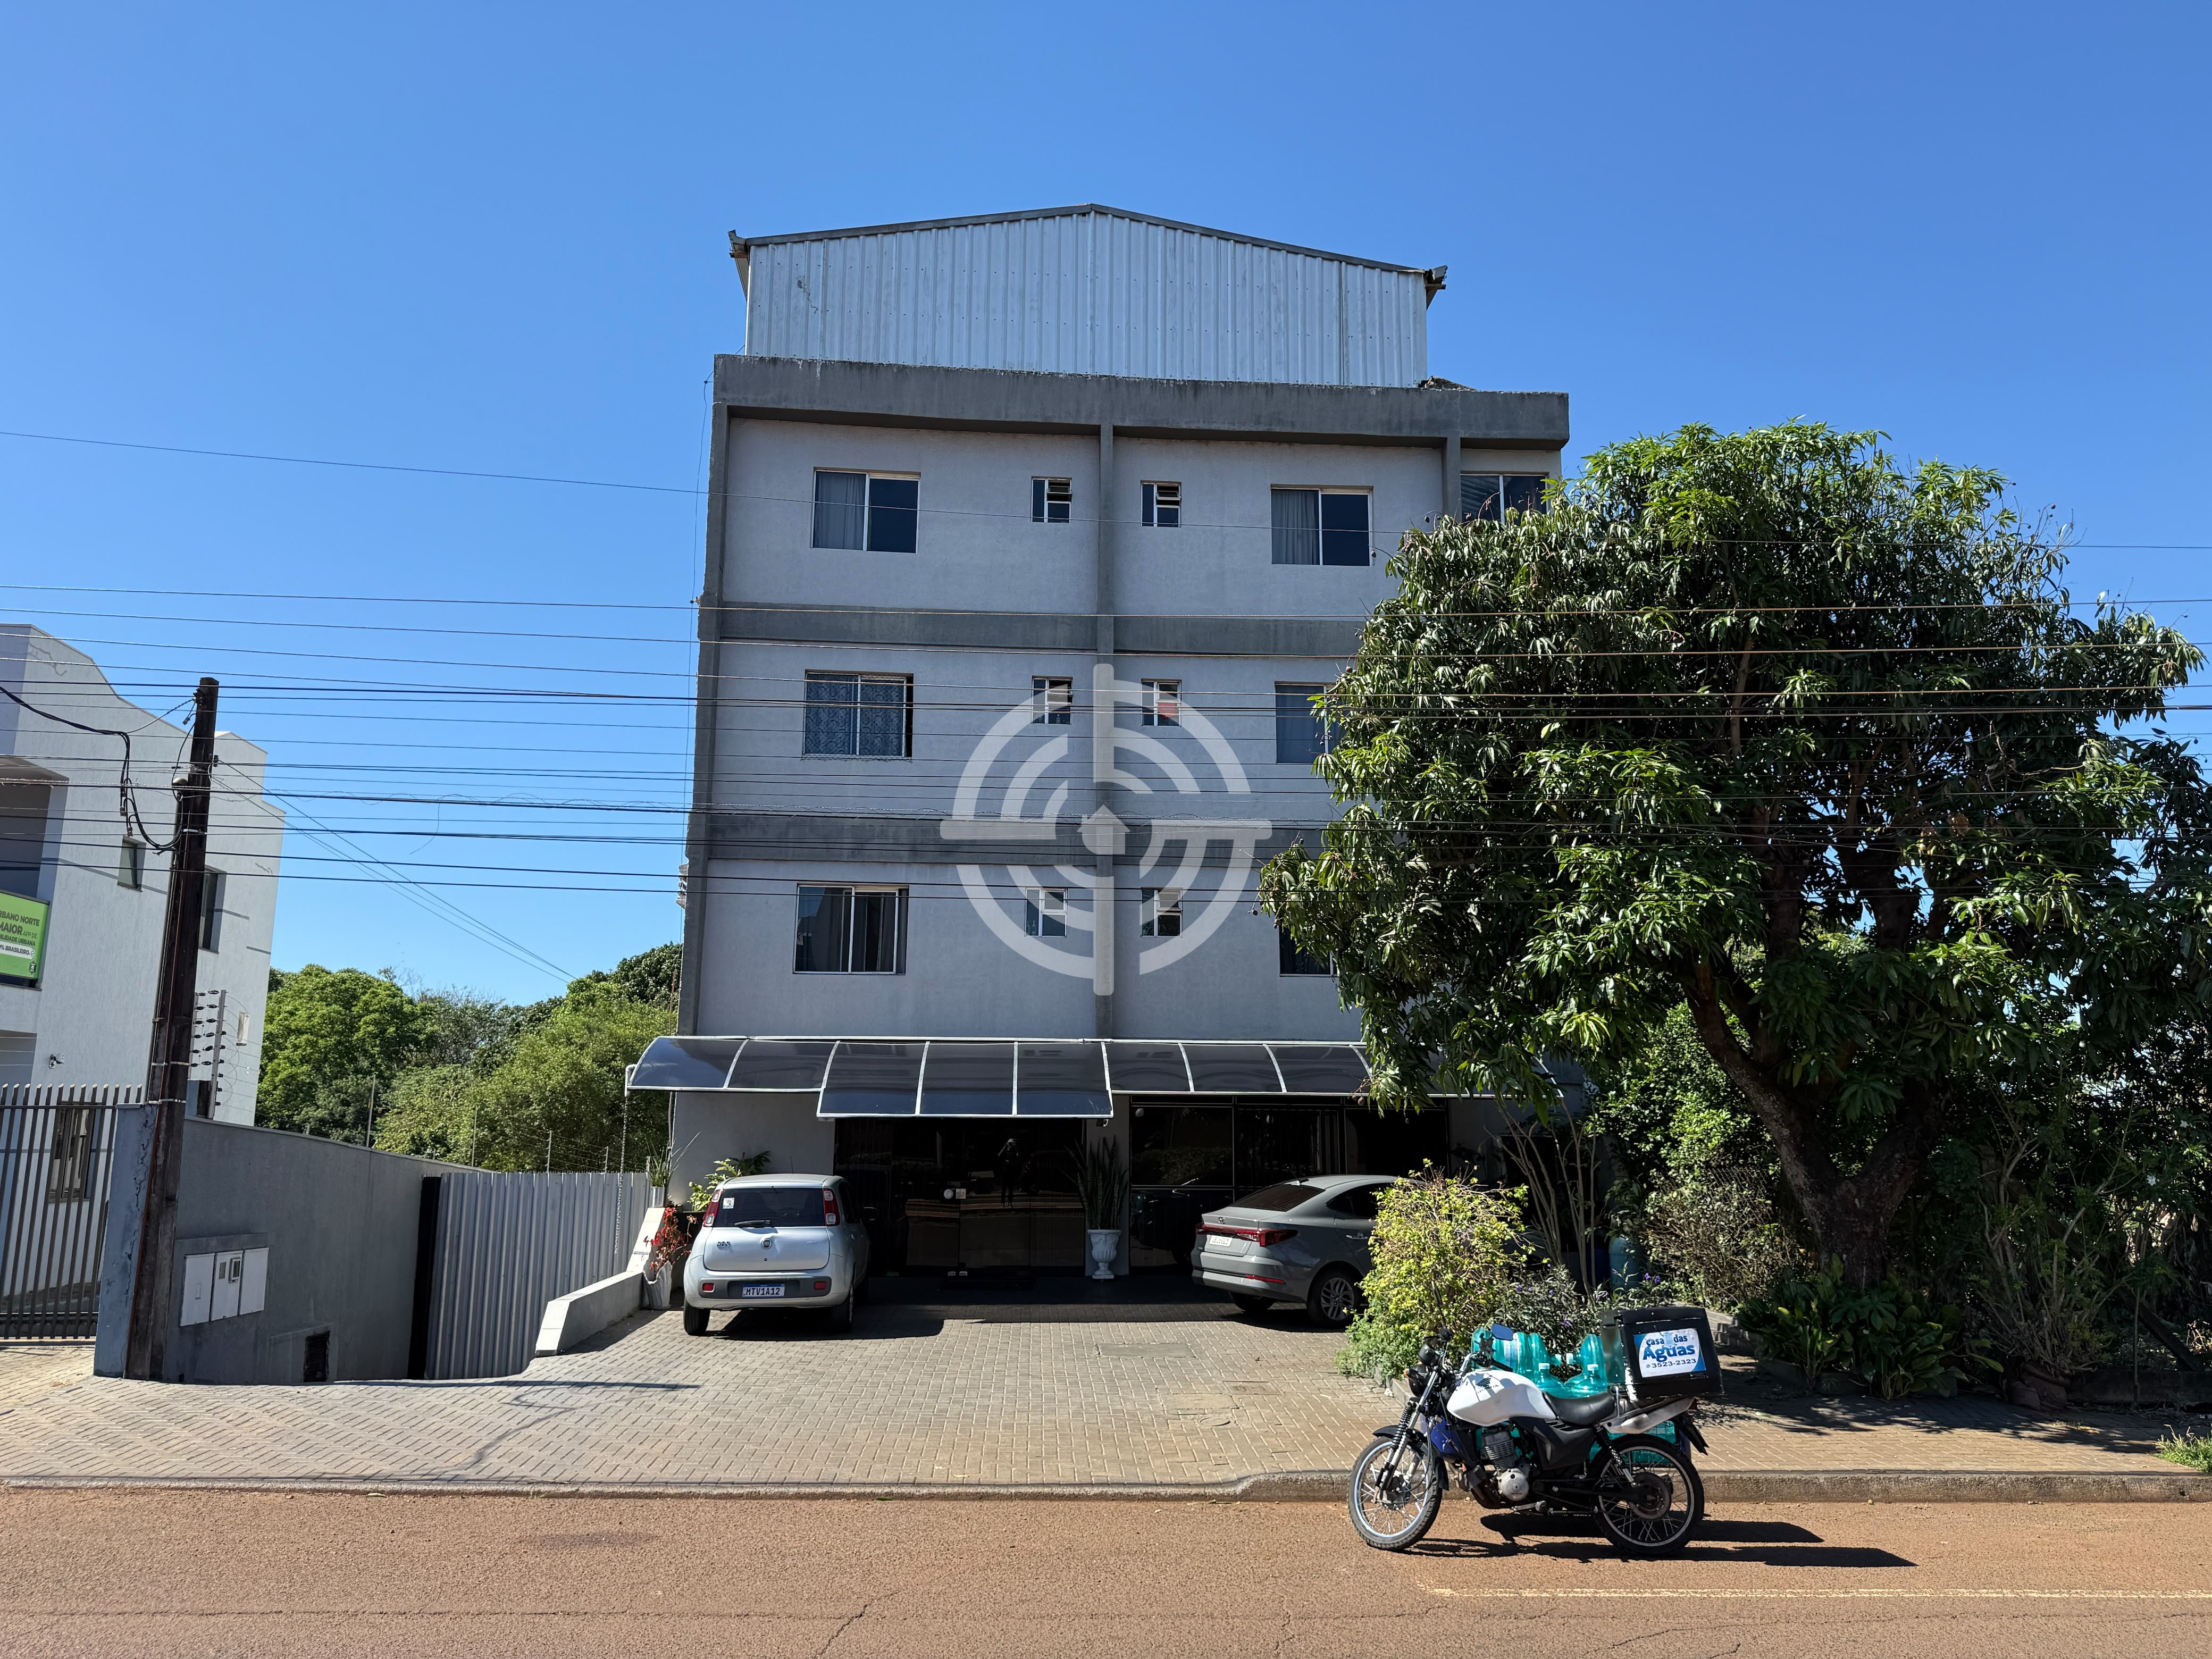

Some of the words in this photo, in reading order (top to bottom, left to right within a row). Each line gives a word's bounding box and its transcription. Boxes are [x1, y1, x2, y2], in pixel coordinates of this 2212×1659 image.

[20, 916, 40, 926] NORTE
[18, 938, 35, 946] URBANA
[1652, 1359, 1696, 1368] 3523-2323
